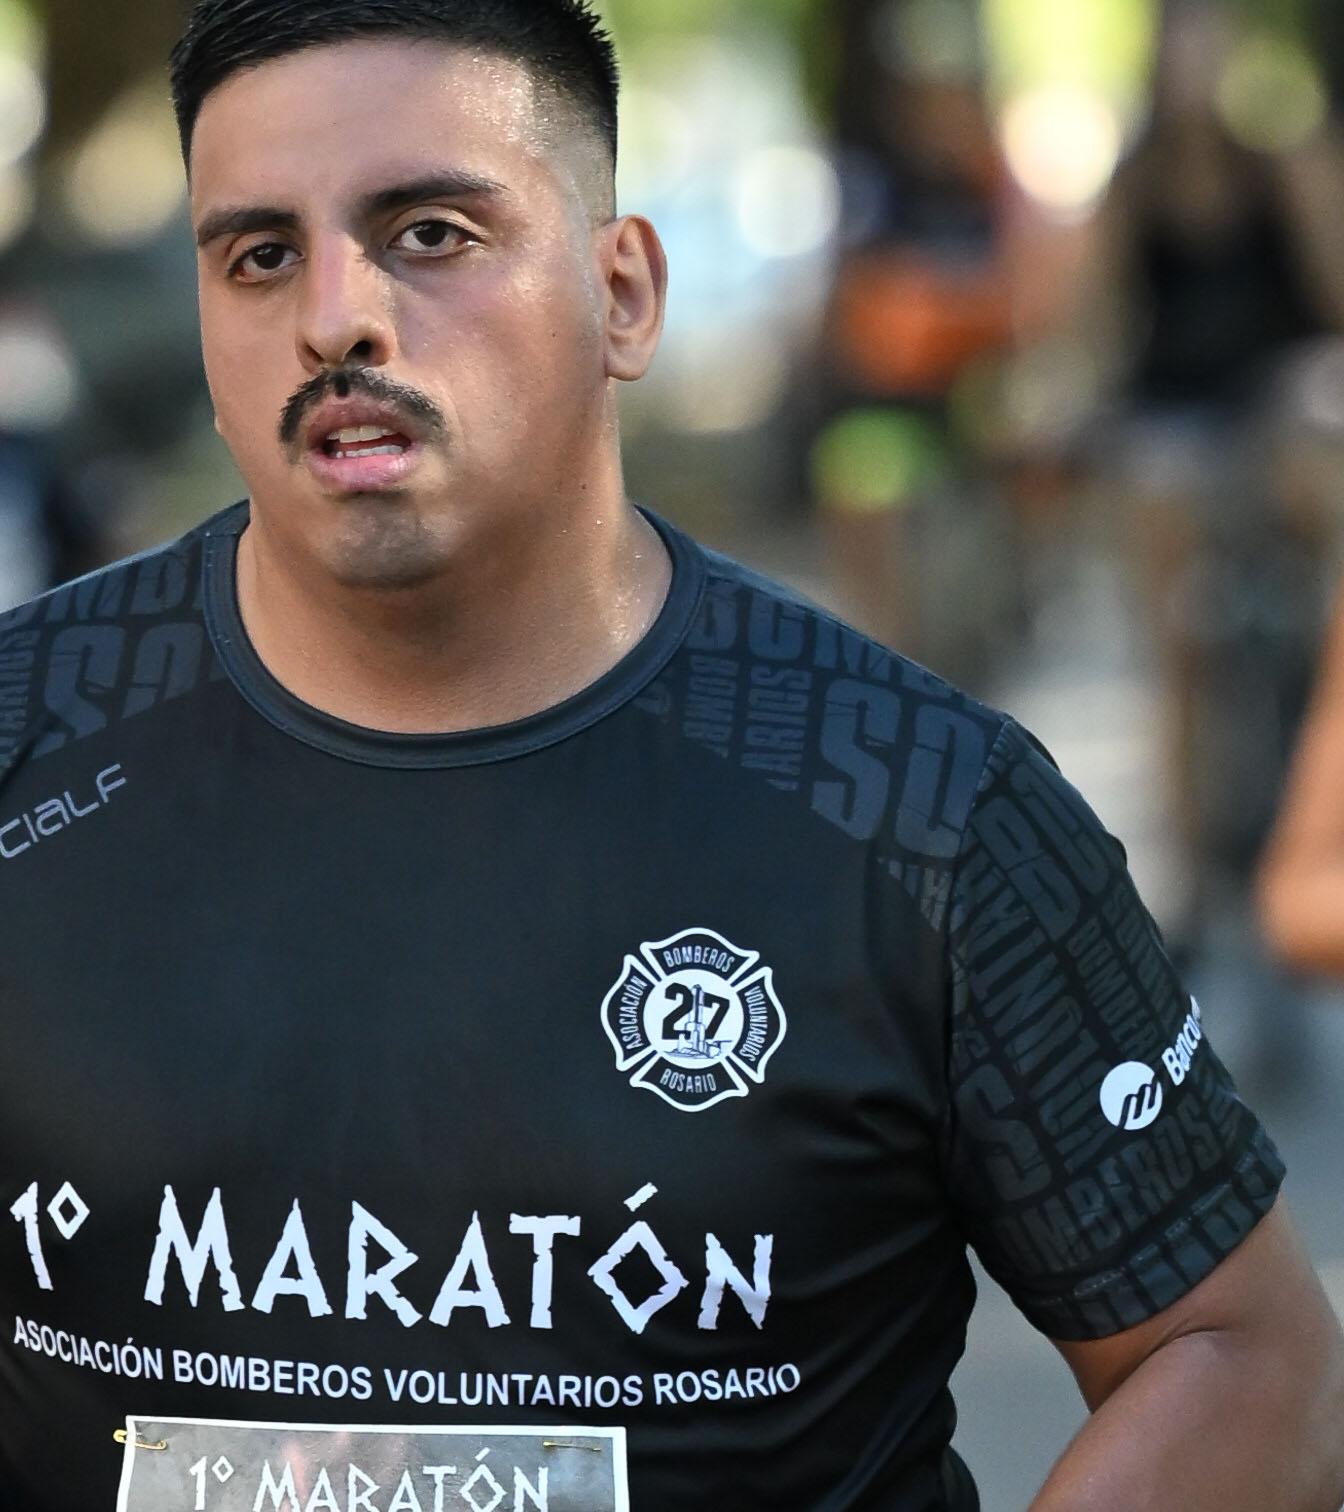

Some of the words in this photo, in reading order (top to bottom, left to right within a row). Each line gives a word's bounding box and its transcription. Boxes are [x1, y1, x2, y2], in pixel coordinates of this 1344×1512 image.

[663, 945, 736, 973] BOMBEROS
[618, 975, 648, 1050] ASOCIACIÓN
[662, 982, 731, 1040] 27
[741, 985, 769, 1063] VOLUNTARIOS
[659, 1068, 717, 1093] ROSARIO
[143, 1182, 774, 1335] MARATÓN
[13, 1315, 164, 1381] ASOCIACIÓN
[172, 1349, 373, 1400] BOMBEROS
[384, 1368, 644, 1408] VOLUNTARIOS
[654, 1363, 801, 1406] ROSARIO
